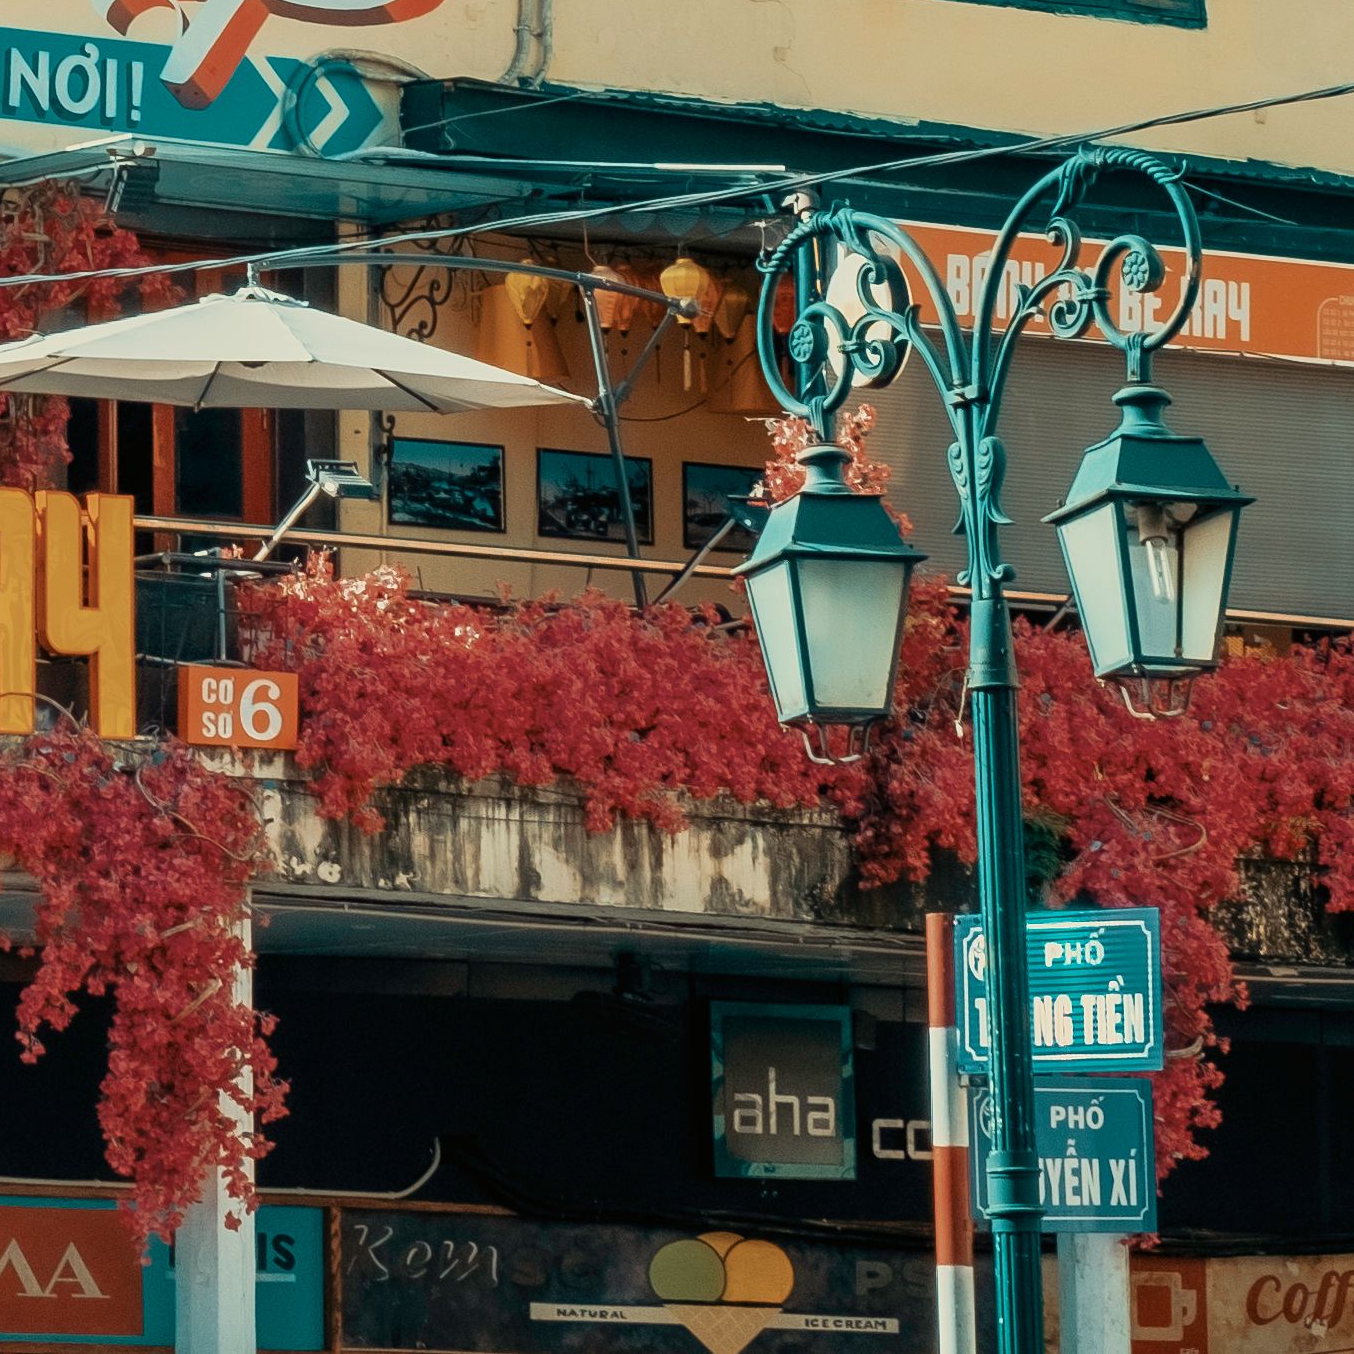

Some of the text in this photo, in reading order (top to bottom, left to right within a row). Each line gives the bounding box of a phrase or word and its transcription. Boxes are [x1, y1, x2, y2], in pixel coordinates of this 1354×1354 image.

[8, 42, 145, 122] NƠI!
[201, 675, 235, 705] CƠ
[239, 678, 283, 741] 6
[1044, 927, 1106, 968] PHỐ
[1080, 974, 1146, 1045] TIỀN
[733, 1066, 837, 1137] aha
[1050, 1095, 1106, 1130] PHỐ
[1109, 1148, 1138, 1207] XÍ
[555, 1307, 888, 1332] NATURAL ICE CREAM
